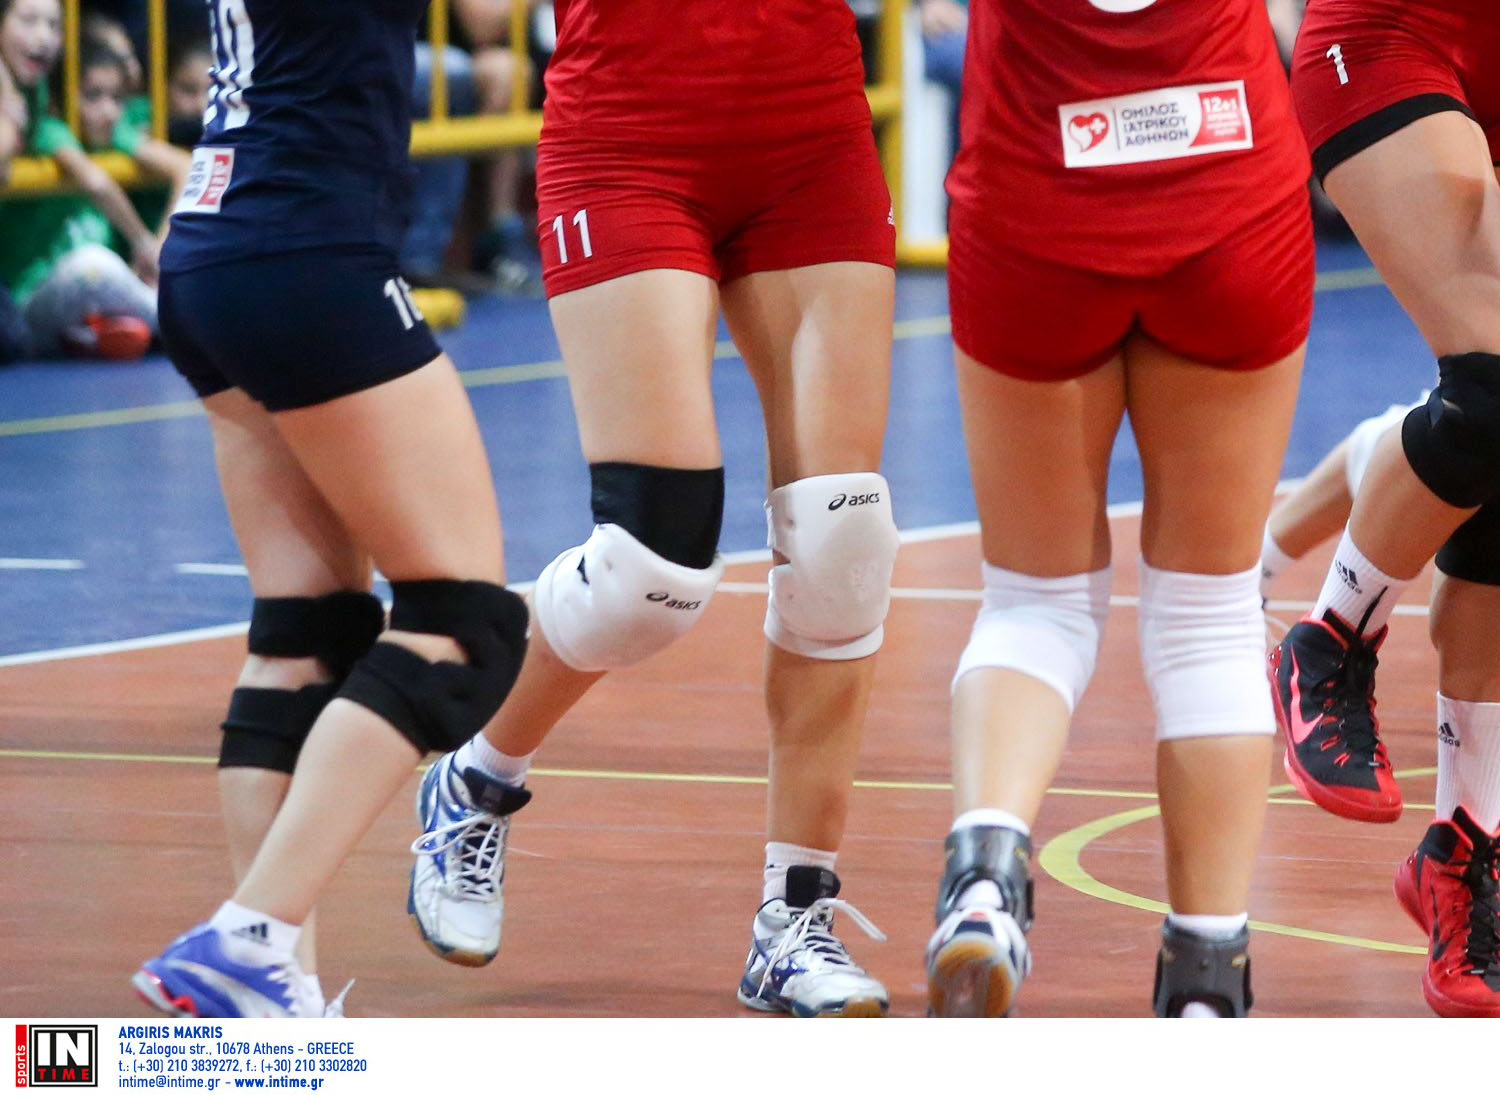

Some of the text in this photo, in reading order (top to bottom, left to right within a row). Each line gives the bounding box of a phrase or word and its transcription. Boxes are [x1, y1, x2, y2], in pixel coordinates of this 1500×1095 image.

[1326, 43, 1349, 85] 1
[1121, 102, 1179, 121] ΟΜΙΛΟΣ
[1123, 115, 1188, 133] ΙΑΤΡΙΚΟΥ
[1125, 130, 1189, 147] ΑΘΗΝΩΝ
[552, 209, 593, 264] 11
[848, 493, 880, 506] asics
